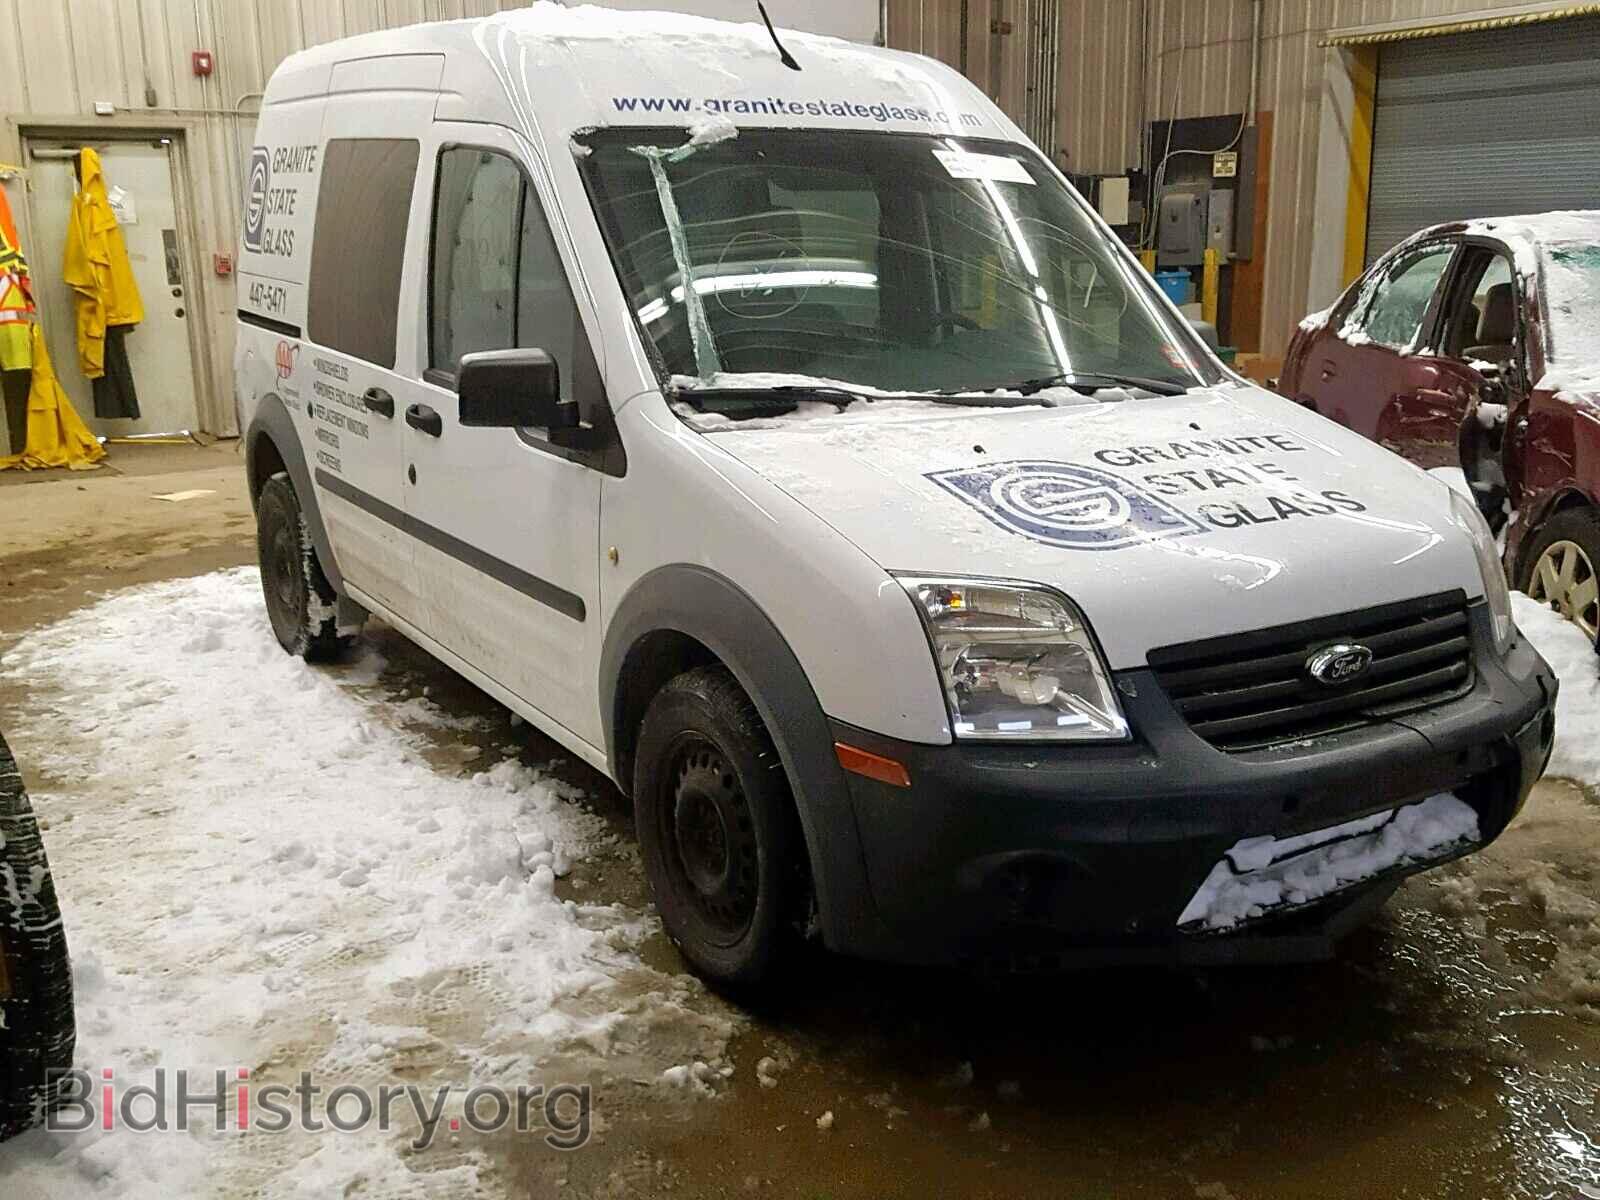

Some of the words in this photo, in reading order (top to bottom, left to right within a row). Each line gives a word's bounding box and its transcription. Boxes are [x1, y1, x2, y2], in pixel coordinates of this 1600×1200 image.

[612, 96, 983, 127] www.granitestateglass.cm
[272, 145, 318, 174] GRANITE
[266, 188, 297, 216] STATE
[263, 228, 295, 258] GLASS
[1094, 434, 1305, 467] GRANITE
[1198, 490, 1367, 529] GLASS
[1331, 654, 1362, 679] Ford
